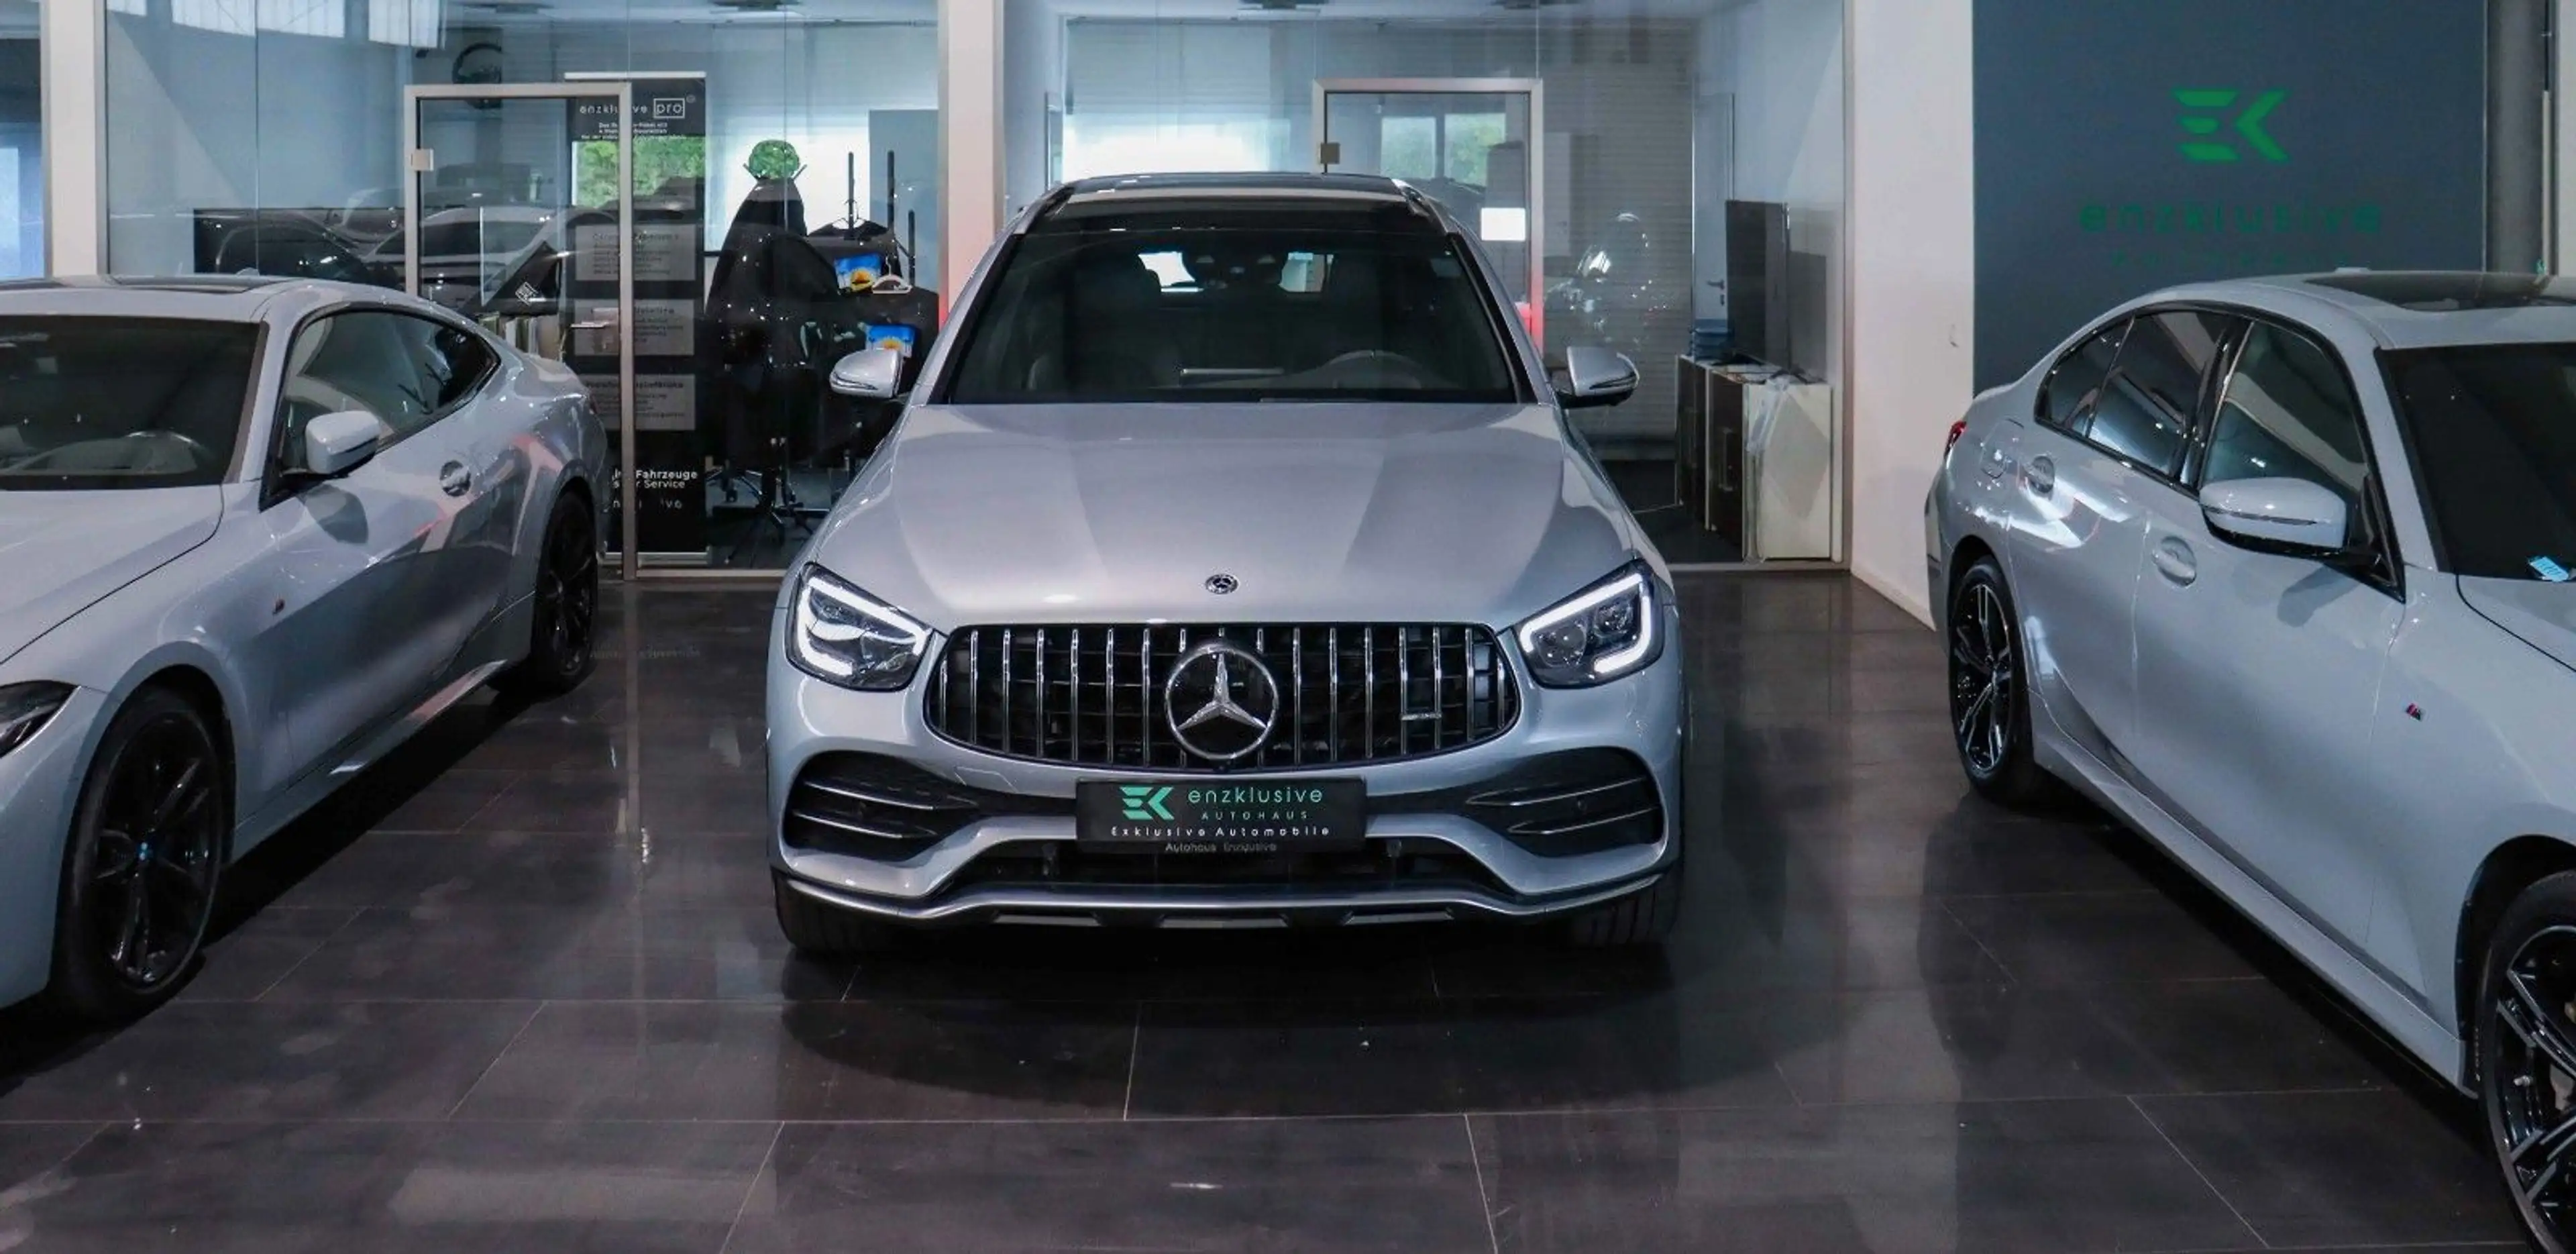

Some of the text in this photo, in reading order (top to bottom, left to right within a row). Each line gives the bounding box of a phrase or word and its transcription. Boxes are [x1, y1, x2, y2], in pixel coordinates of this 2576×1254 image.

[656, 103, 683, 115] pro
[2079, 201, 2381, 233] enzklusive
[635, 470, 698, 480] Fahrzeuge
[644, 480, 686, 488] Service
[1120, 786, 1323, 820] EK enzklusive
[1201, 811, 1307, 820] AUTOHAUS
[1111, 826, 1330, 837] Exklusive Automobile
[1165, 842, 1216, 853] Autohaus
